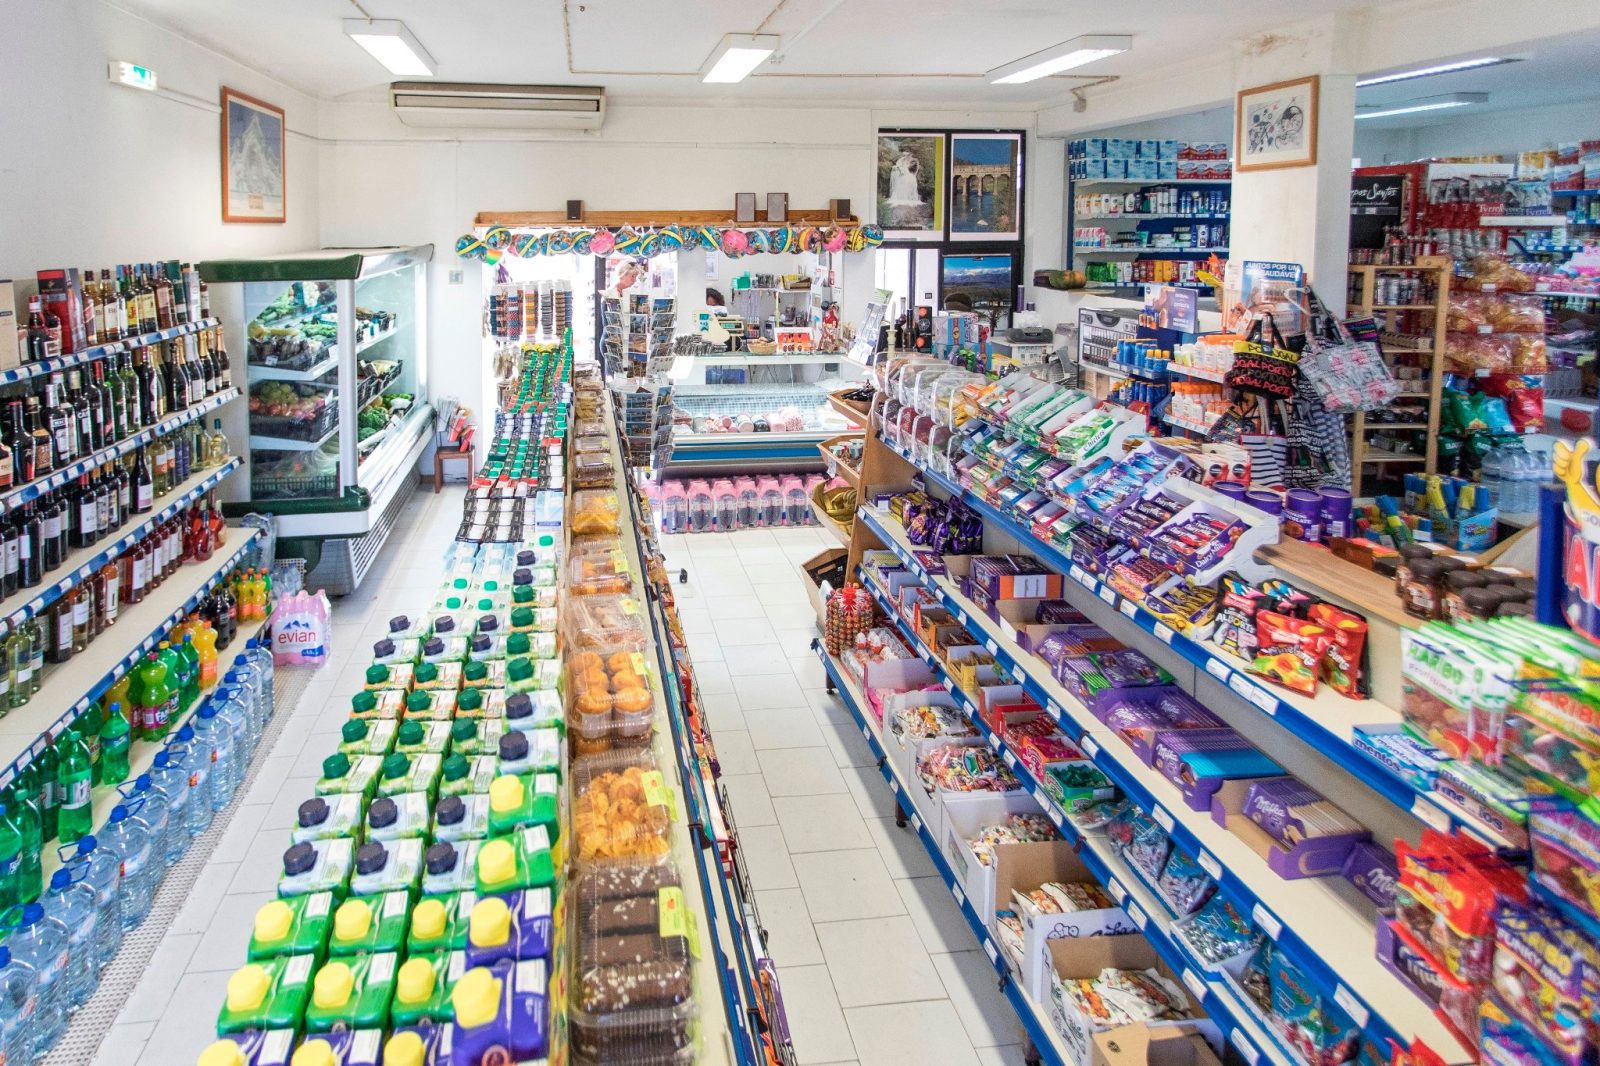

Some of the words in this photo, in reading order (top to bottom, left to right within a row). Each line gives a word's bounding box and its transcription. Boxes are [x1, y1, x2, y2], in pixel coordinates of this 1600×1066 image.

[278, 630, 316, 644] evian
[1353, 738, 1401, 773] mentos
[1254, 795, 1286, 817] Milka
